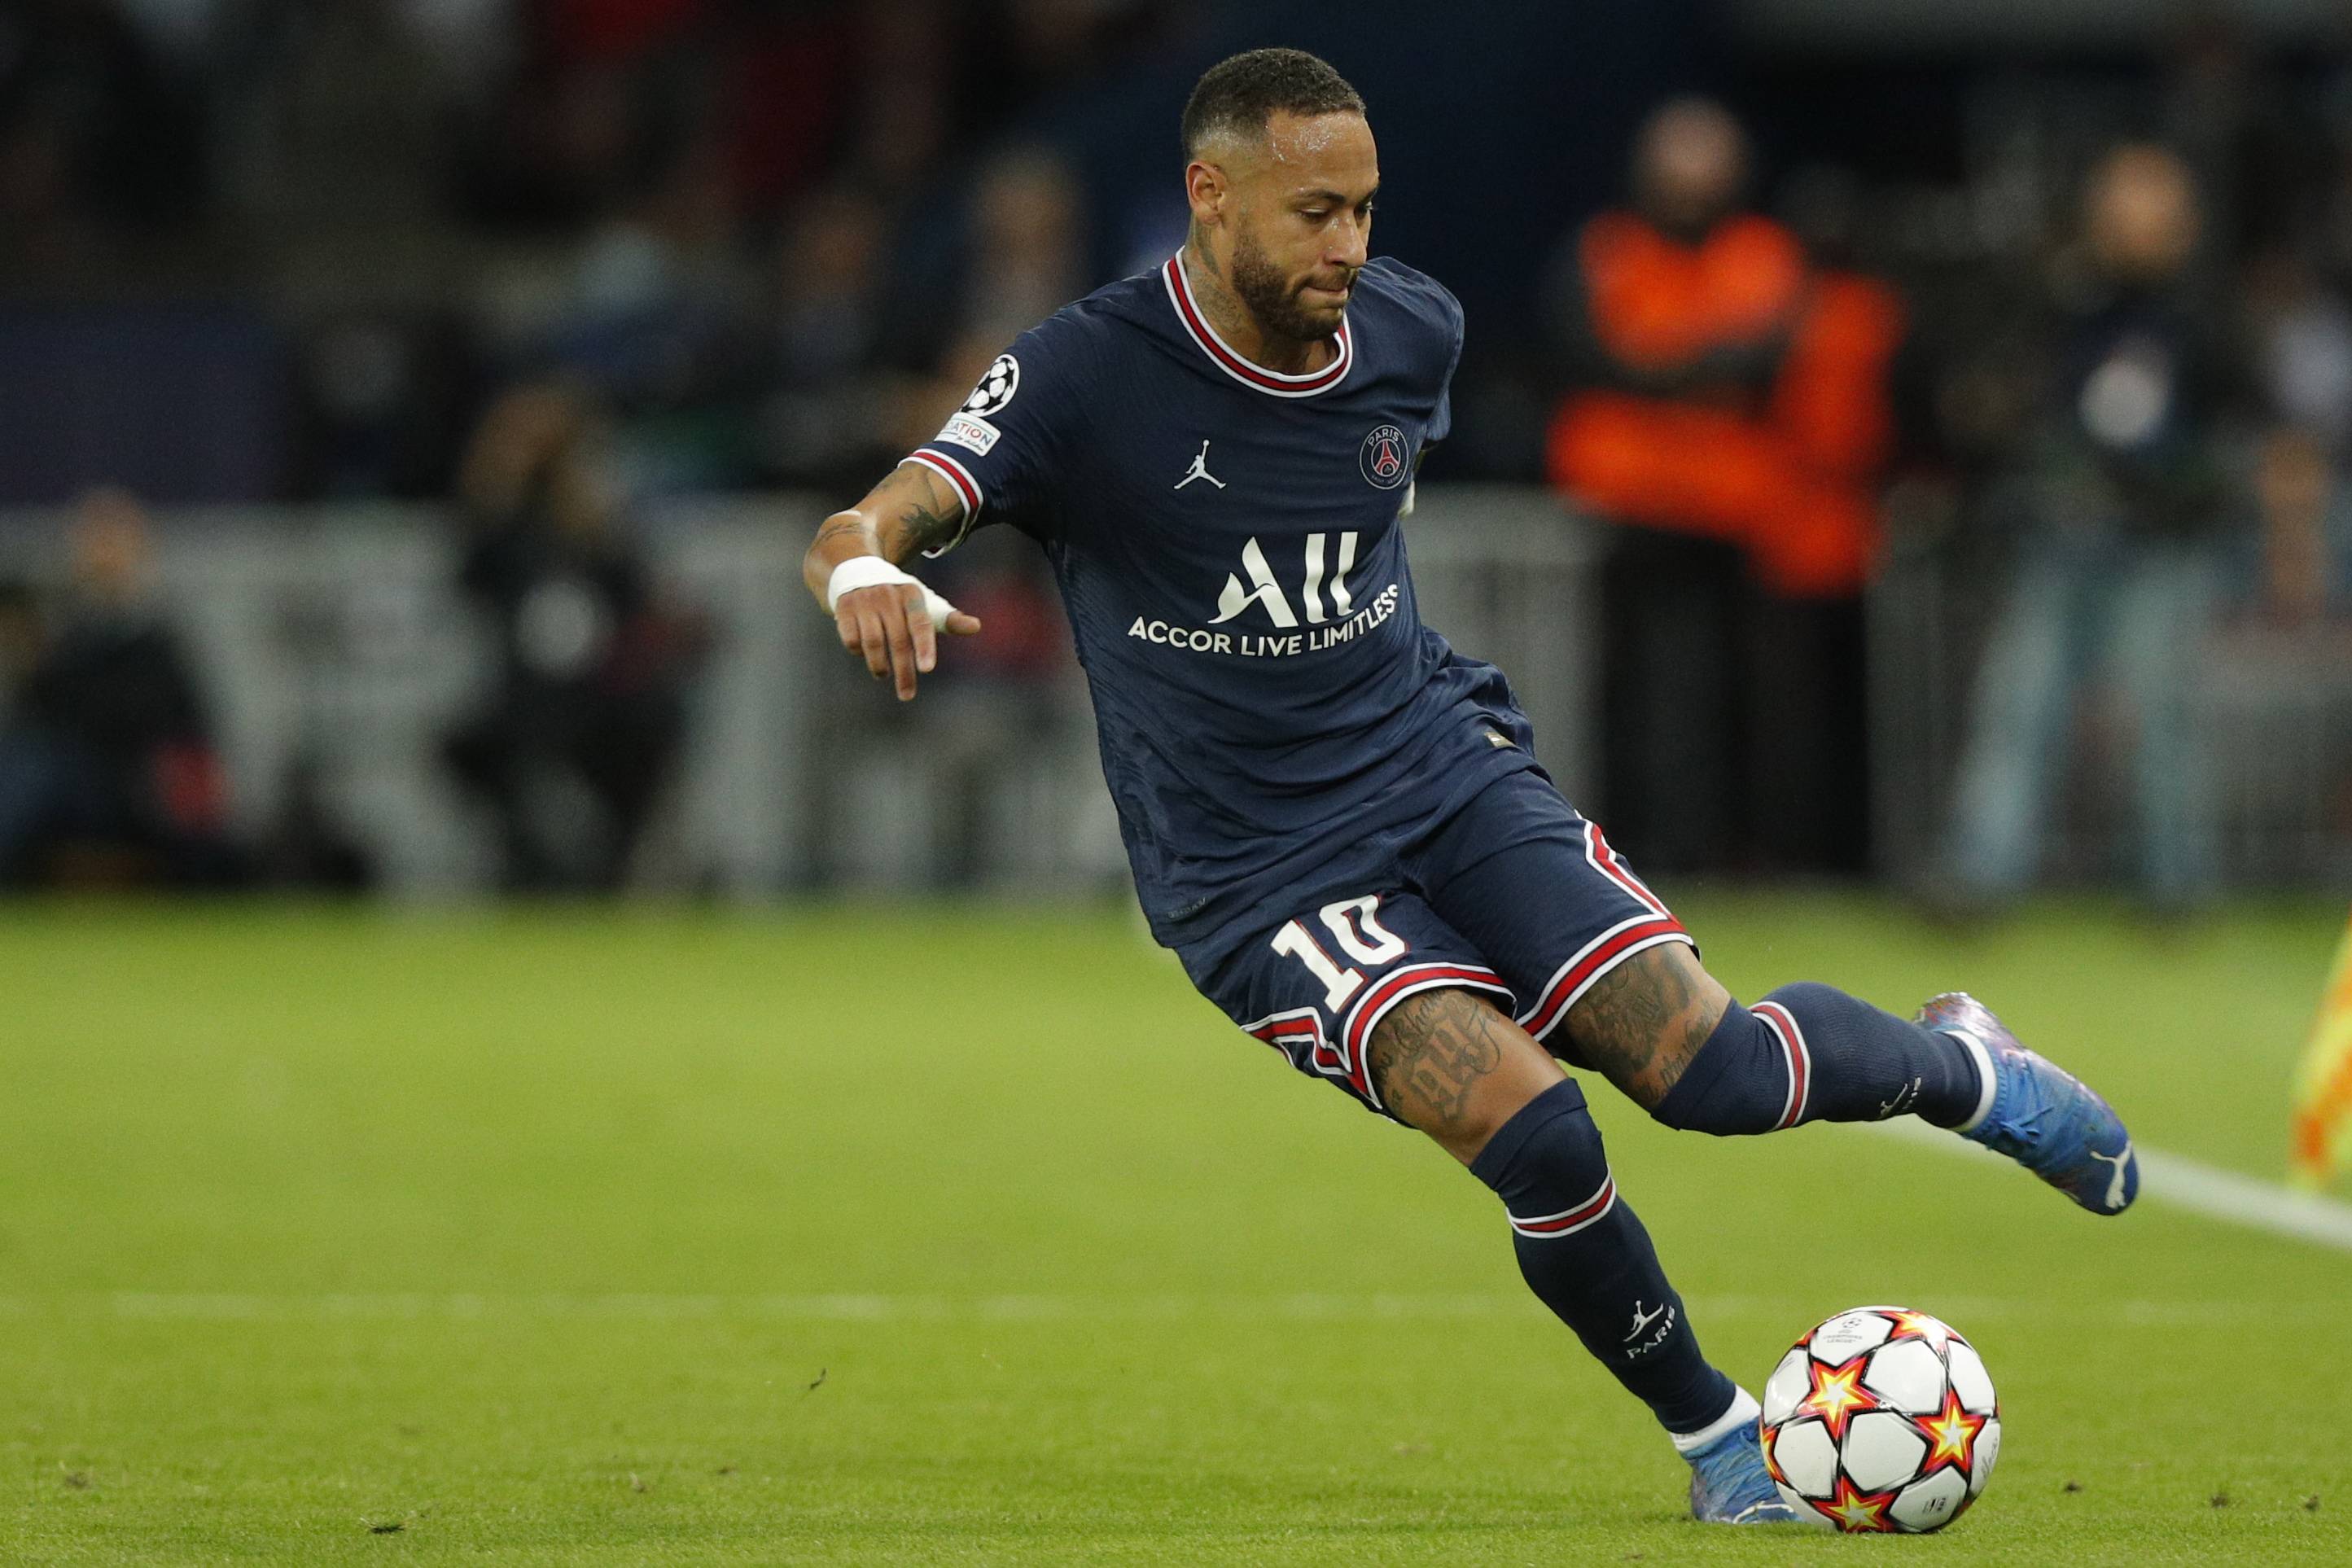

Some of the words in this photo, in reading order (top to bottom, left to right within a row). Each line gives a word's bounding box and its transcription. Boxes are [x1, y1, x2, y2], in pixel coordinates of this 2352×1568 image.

[947, 422, 992, 446] ATION
[1368, 428, 1399, 446] PARIS
[1128, 616, 1232, 655] ACCOR
[1241, 634, 1303, 657] LIVE
[1270, 894, 1412, 1014] 10
[1627, 1305, 1675, 1359] PARIS
